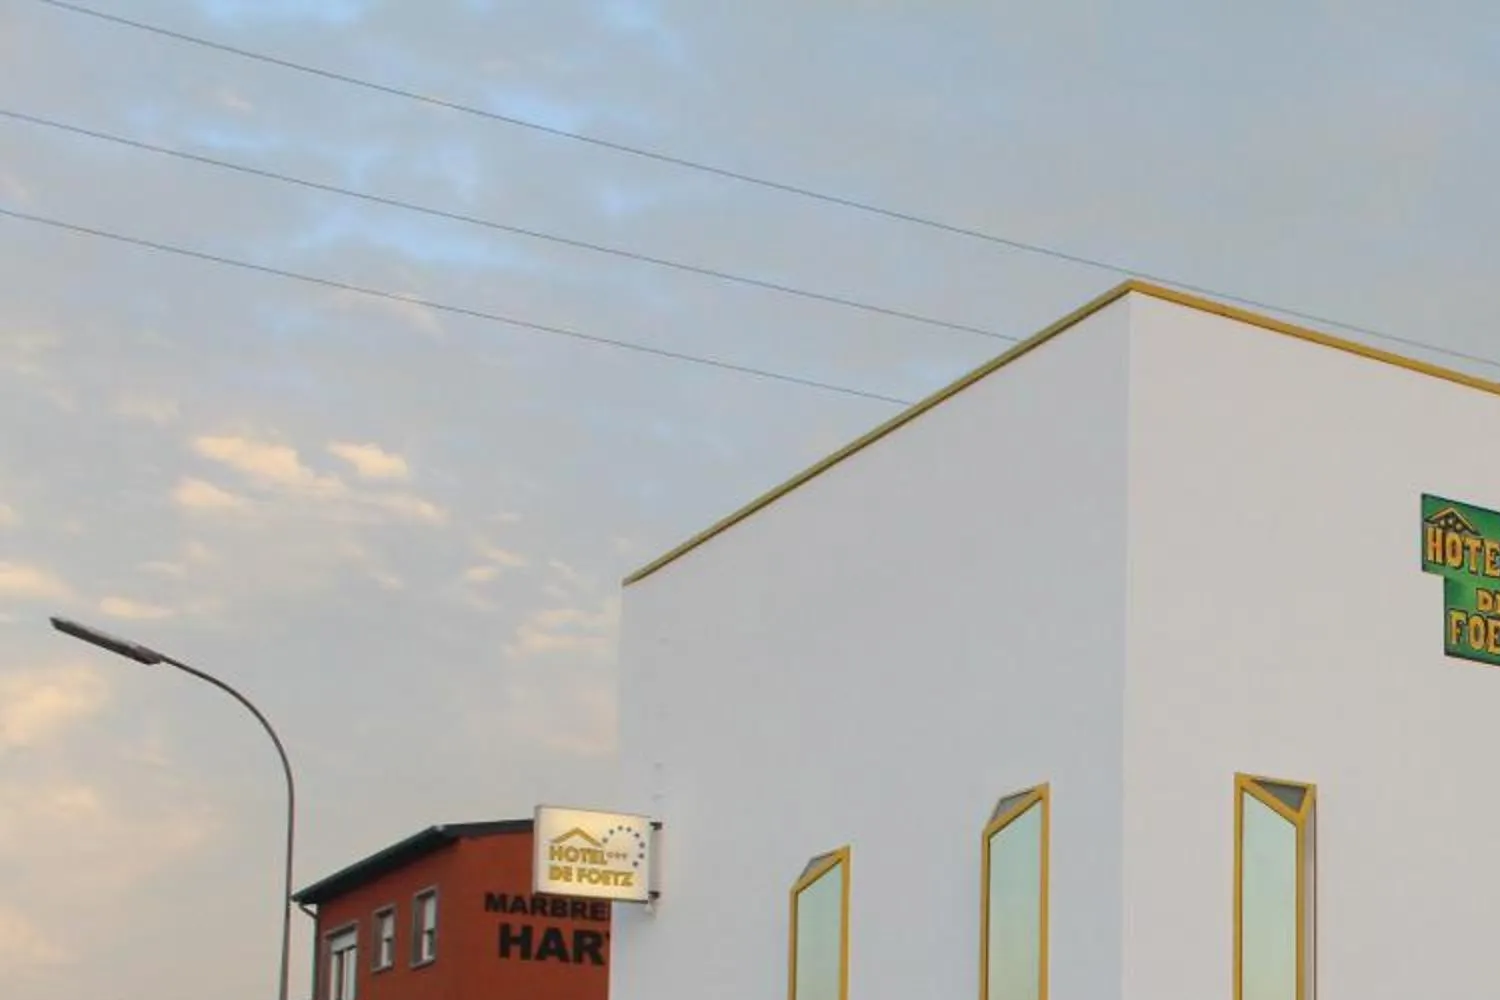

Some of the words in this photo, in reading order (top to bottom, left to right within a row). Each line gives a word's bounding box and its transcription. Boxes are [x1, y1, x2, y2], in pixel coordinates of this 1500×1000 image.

[549, 845, 607, 865] HOTEL
[549, 866, 573, 882] DE
[577, 869, 634, 887] FOETZ
[485, 892, 611, 921] MARBRE
[499, 923, 611, 966] HAR
